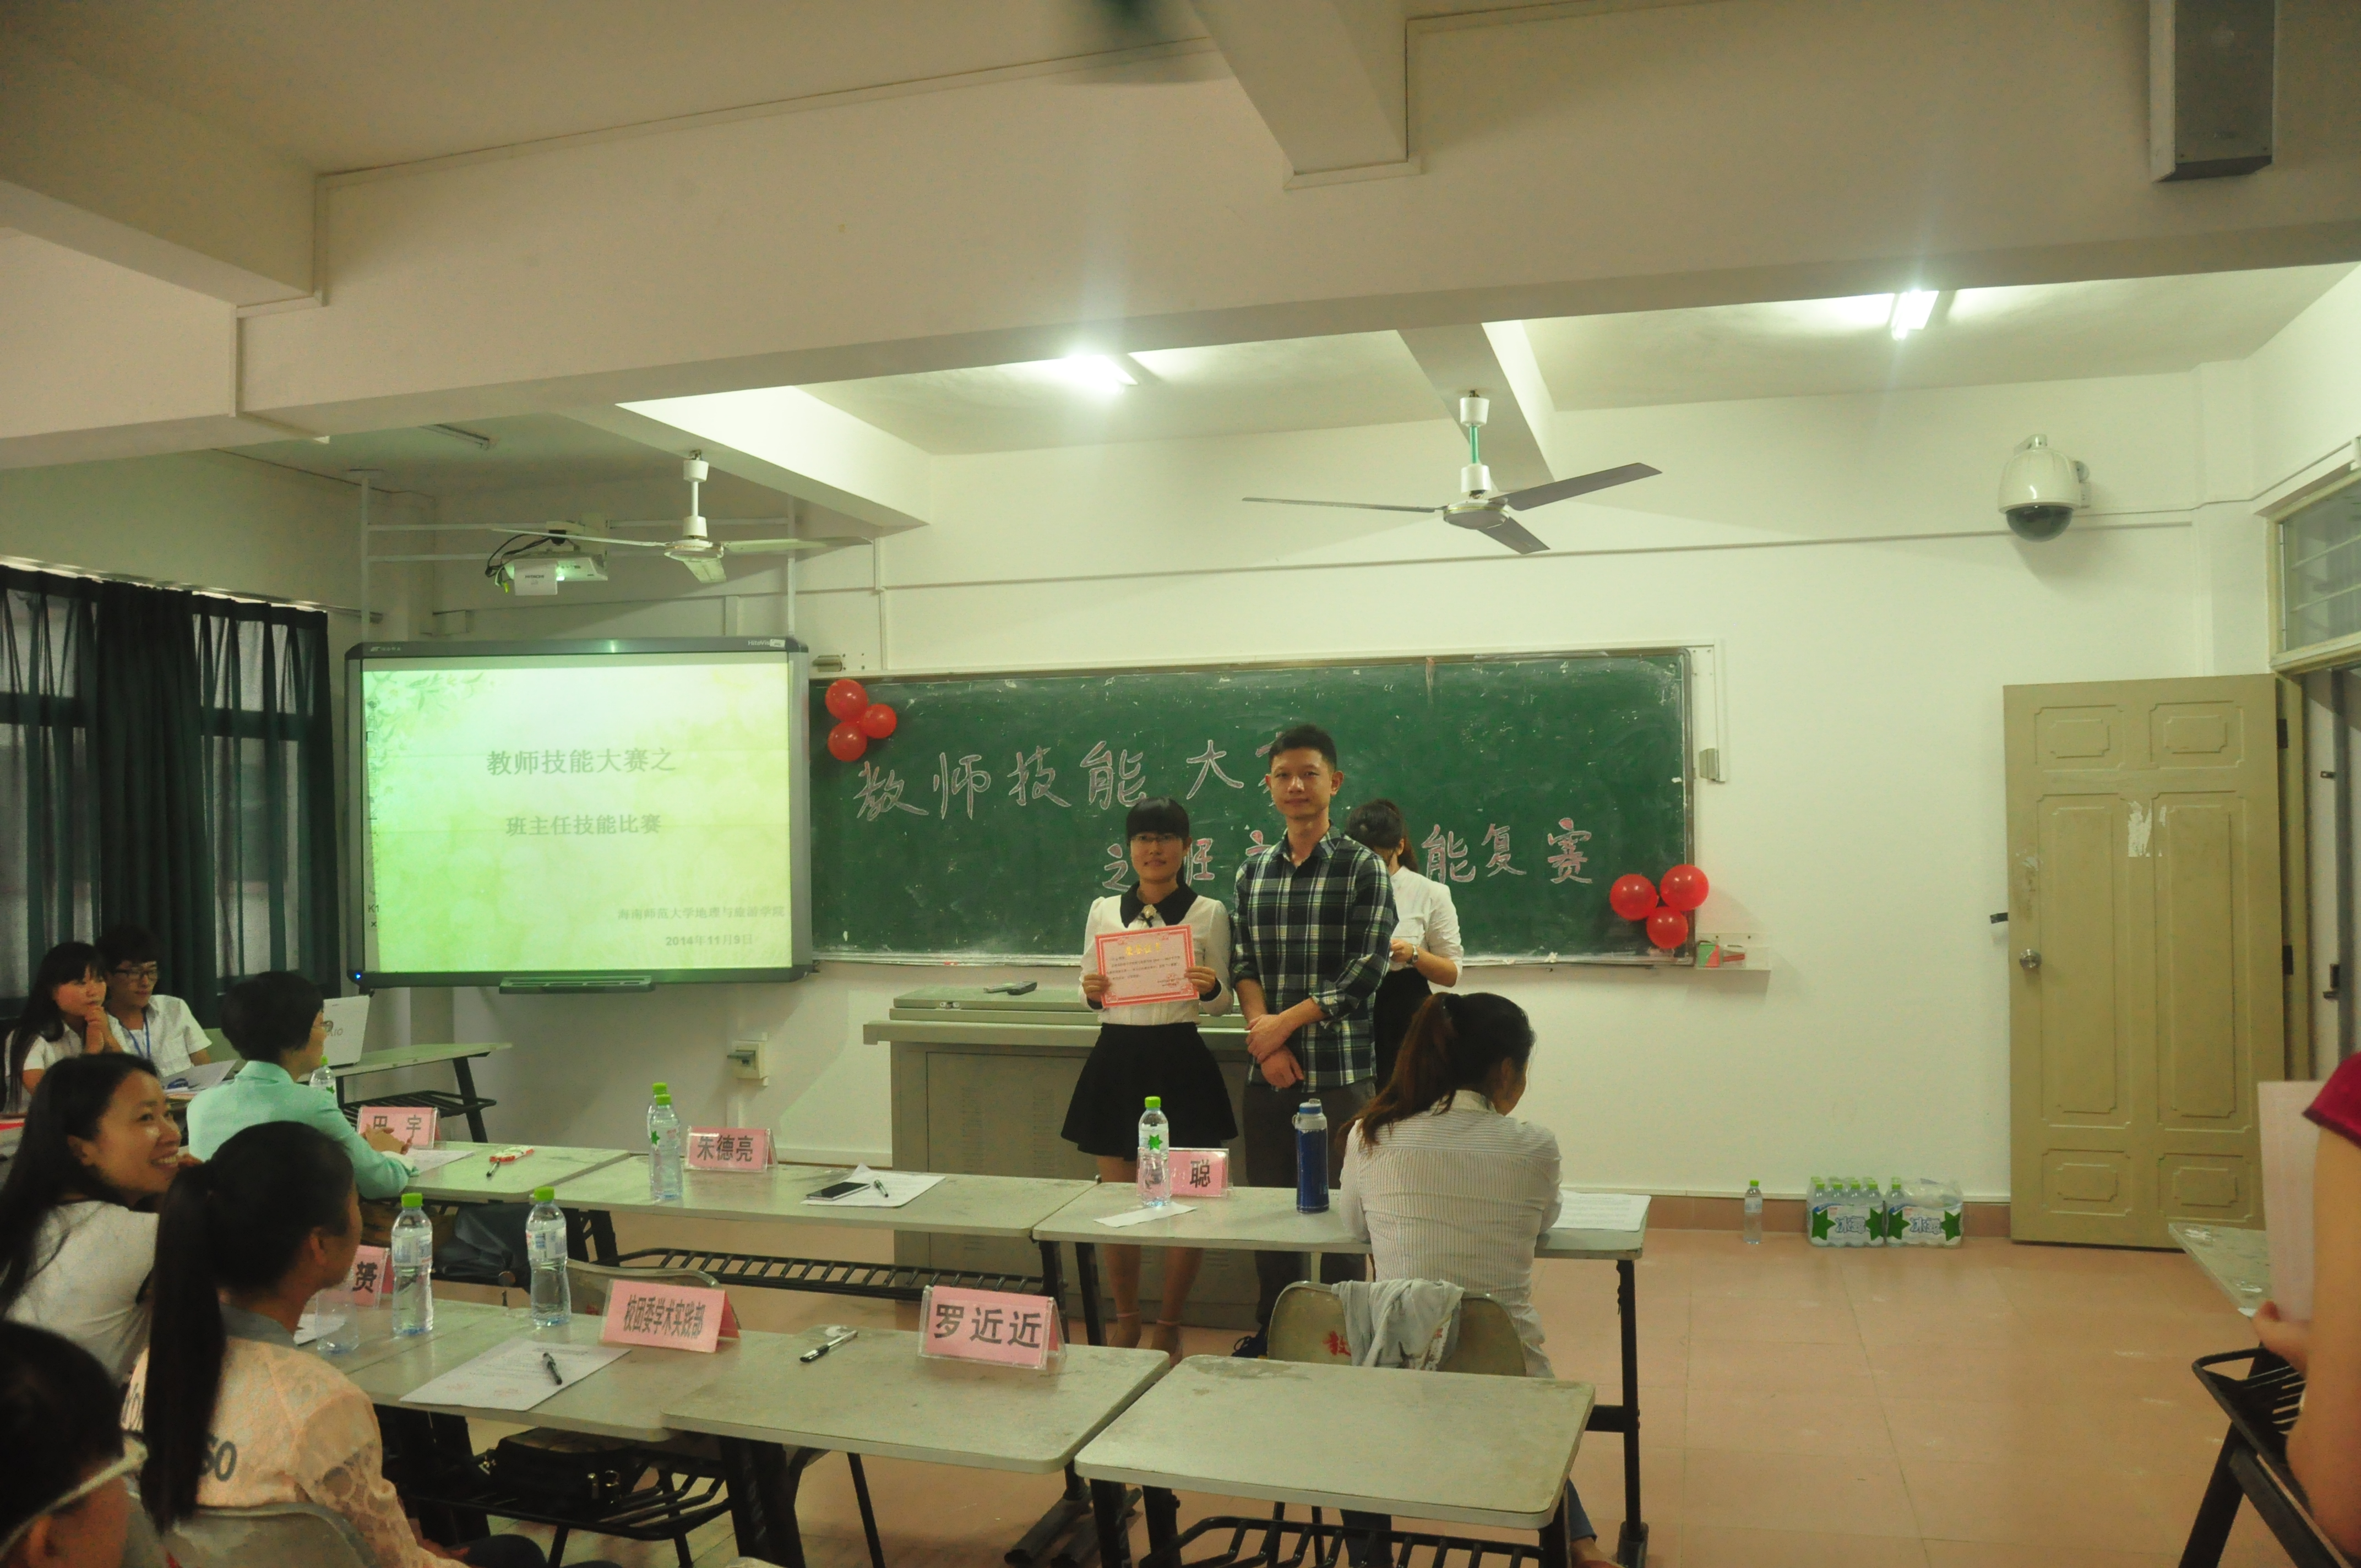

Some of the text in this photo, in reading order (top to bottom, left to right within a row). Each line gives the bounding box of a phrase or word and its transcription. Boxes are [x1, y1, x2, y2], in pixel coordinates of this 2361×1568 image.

[487, 748, 676, 776] 教师技能大赛之
[853, 732, 1279, 821] 教师技能大
[505, 813, 661, 836] 班主任技能比赛
[617, 906, 785, 920] 海南师范大学地理与旅游学院
[665, 934, 753, 946] 2014年11月9日
[697, 1134, 754, 1162] 朱德亮
[623, 1294, 706, 1340] 校团委学术实践部
[934, 1304, 1042, 1349] 罗近近
